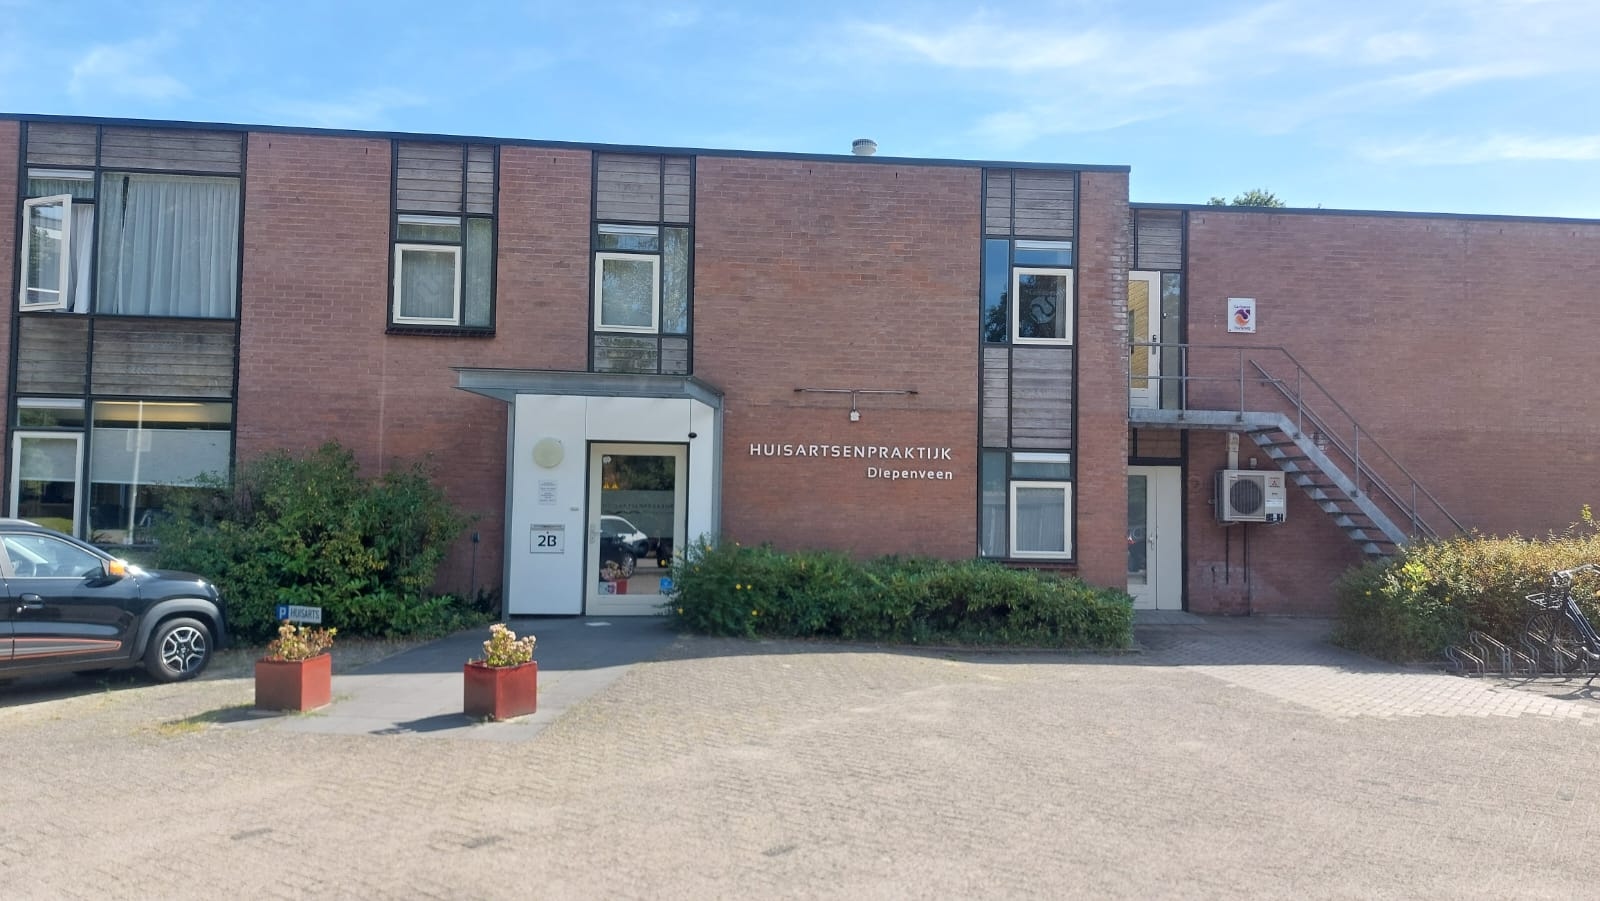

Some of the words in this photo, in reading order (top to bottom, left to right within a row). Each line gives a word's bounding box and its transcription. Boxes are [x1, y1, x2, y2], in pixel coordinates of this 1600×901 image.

[749, 443, 952, 460] HUISARTSENPRAKTIJK
[867, 467, 953, 481] Diepenveen
[537, 534, 557, 547] 2B
[290, 607, 320, 620] HUISARTS
